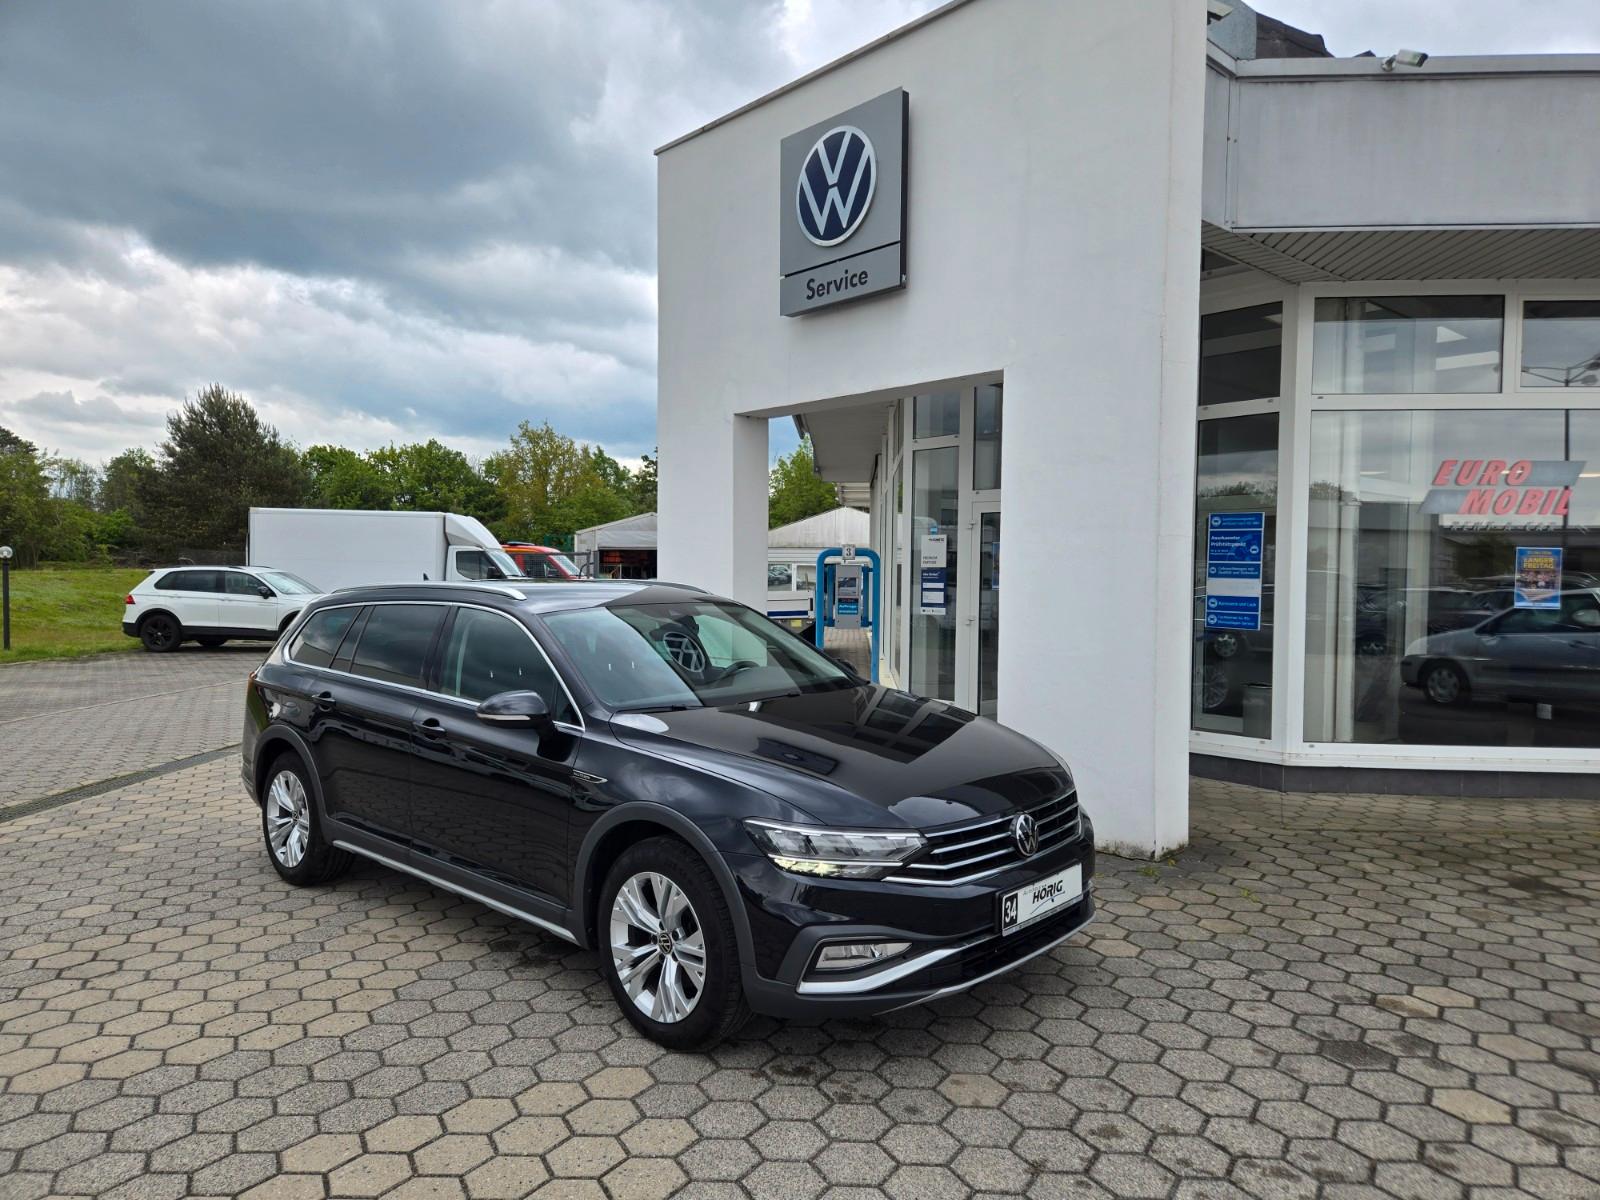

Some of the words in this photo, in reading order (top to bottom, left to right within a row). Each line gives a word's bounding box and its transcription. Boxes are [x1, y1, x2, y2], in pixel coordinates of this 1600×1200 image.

[806, 269, 868, 300] Service
[1431, 459, 1533, 486] EURO
[1456, 488, 1573, 515] MOBIL
[846, 547, 851, 556] 3
[1005, 898, 1017, 923] 34
